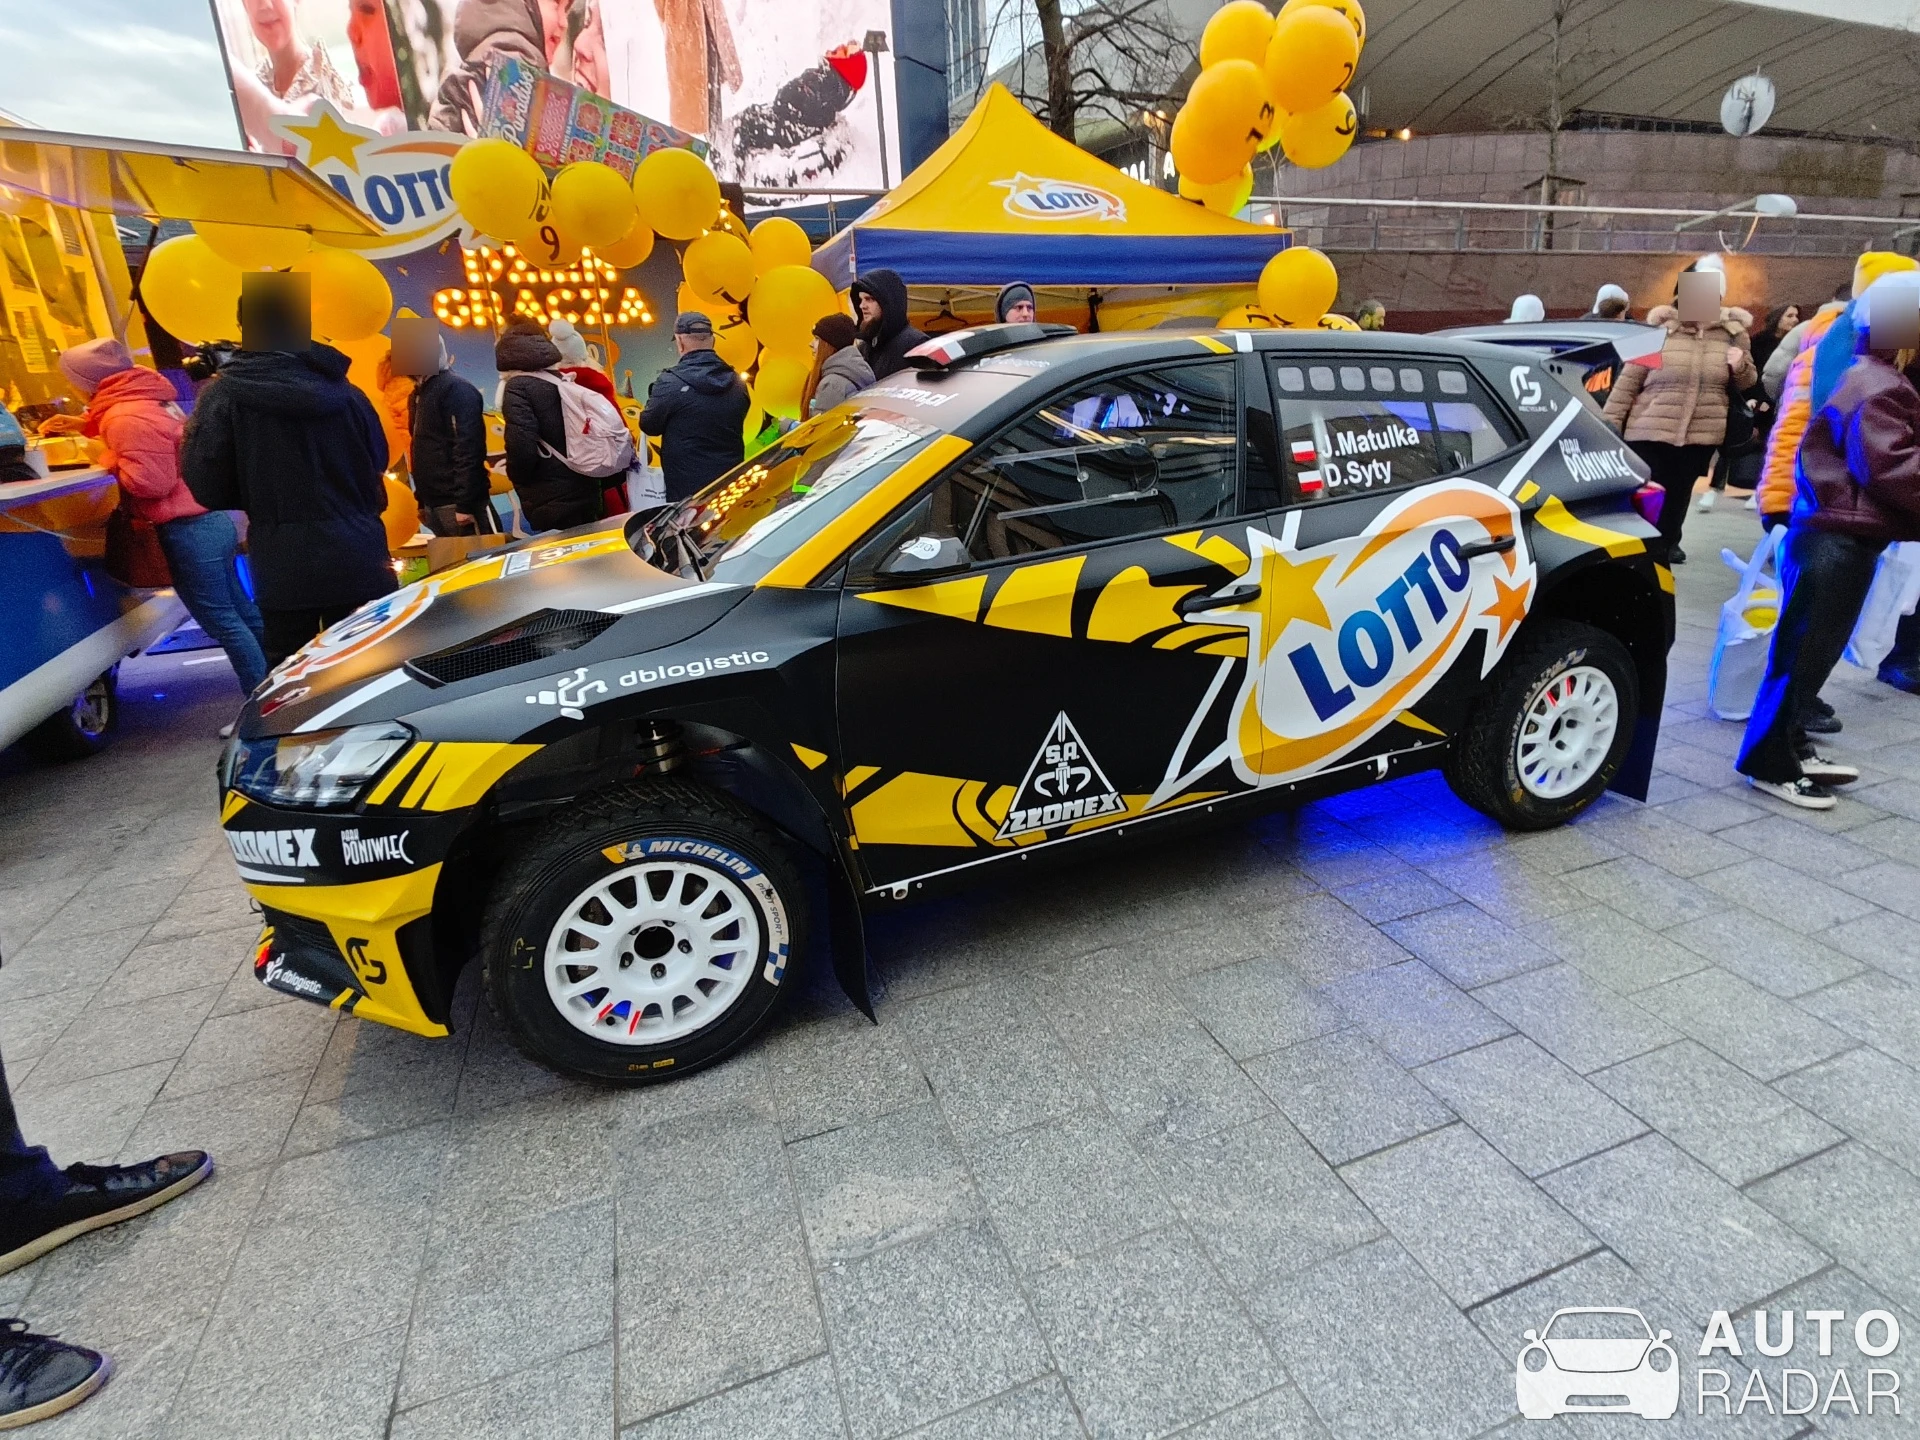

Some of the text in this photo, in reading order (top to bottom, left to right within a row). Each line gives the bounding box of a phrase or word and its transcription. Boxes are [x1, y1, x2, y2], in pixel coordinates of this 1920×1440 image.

[501, 68, 535, 149] Paradiso
[1026, 192, 1099, 210] LOTTO
[432, 287, 655, 328] GRACZA
[1320, 424, 1420, 459] J.Matulka
[1324, 459, 1392, 488] D.Syty
[1287, 528, 1470, 723] LOTTO
[619, 650, 770, 687] dblogistic
[1045, 741, 1080, 765] S.A.
[648, 840, 753, 875] MICHELIN
[769, 906, 782, 936] SPORT
[280, 968, 323, 995] dblogistic
